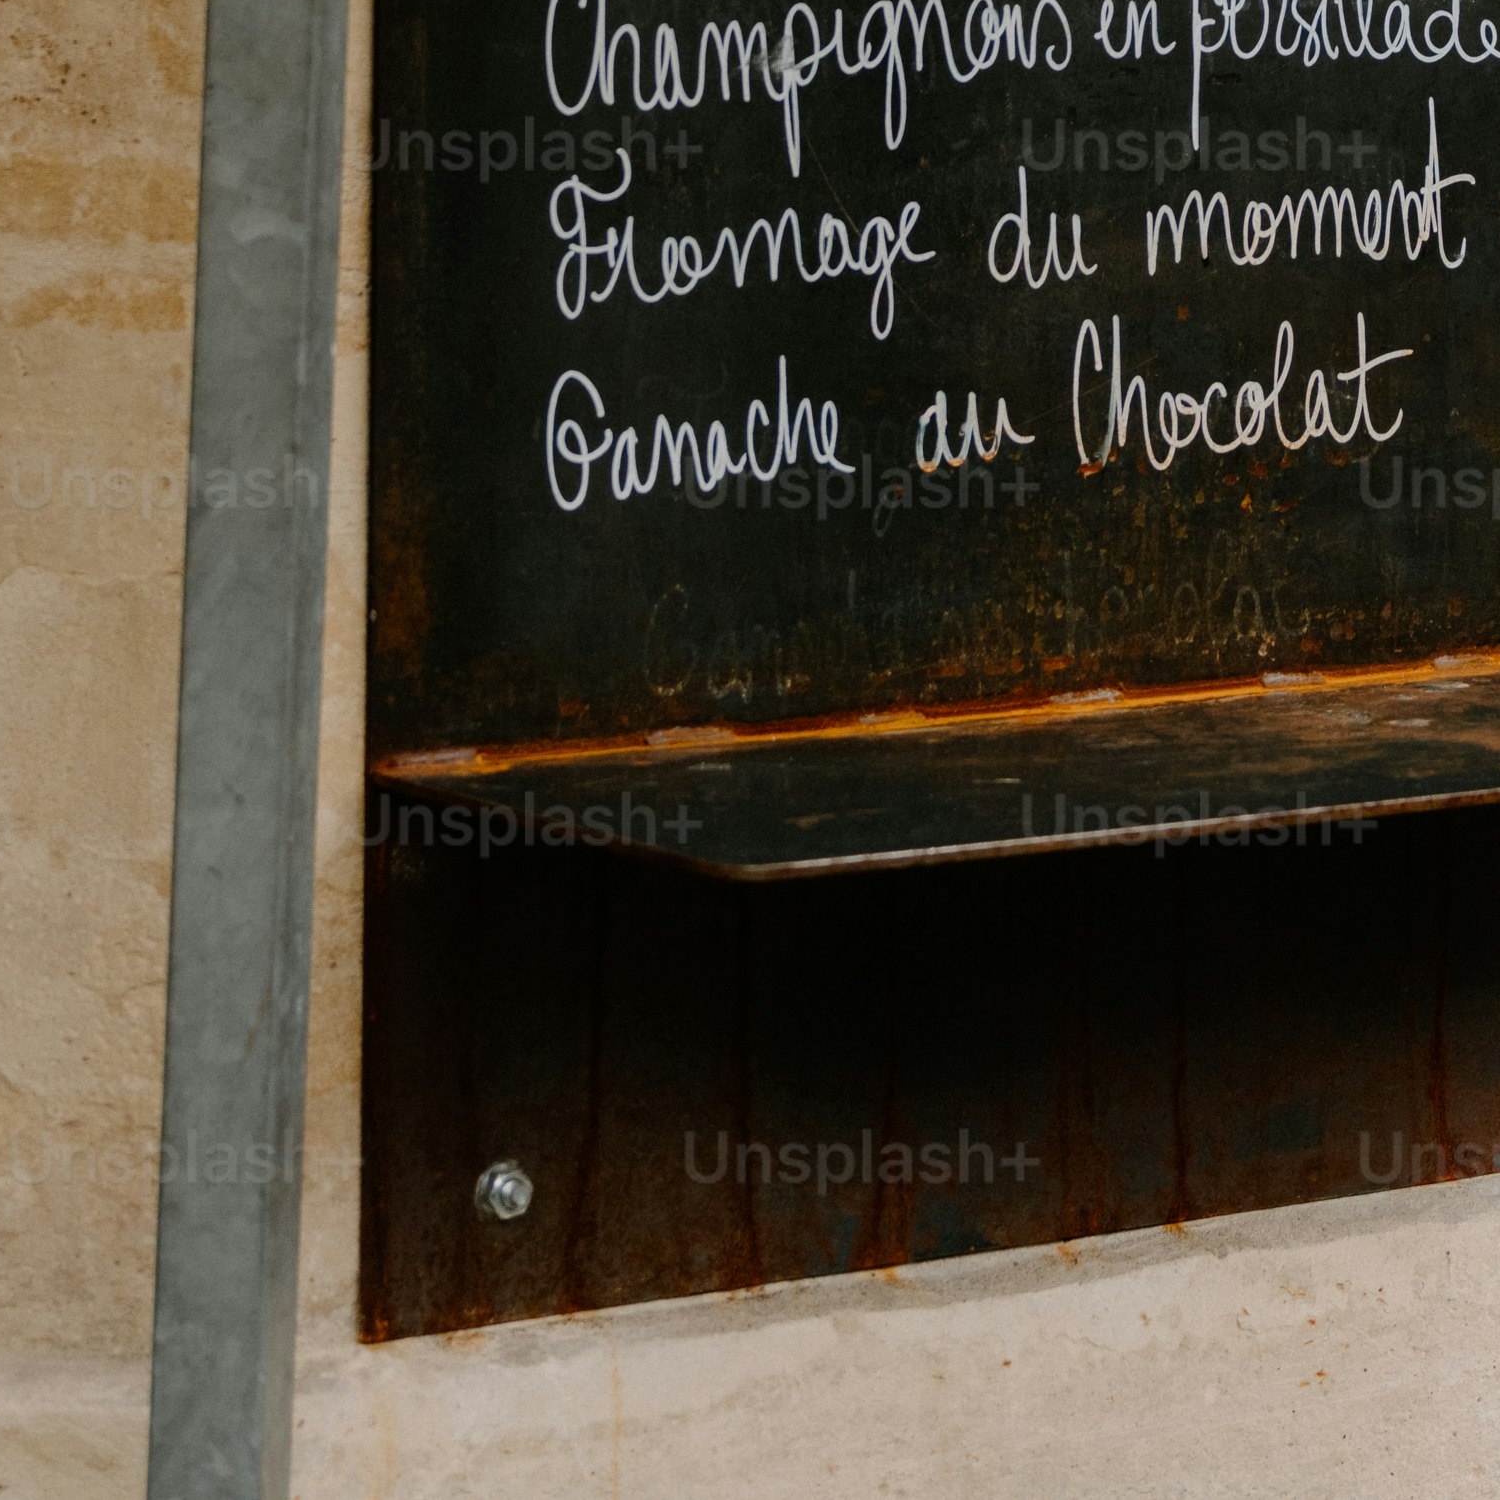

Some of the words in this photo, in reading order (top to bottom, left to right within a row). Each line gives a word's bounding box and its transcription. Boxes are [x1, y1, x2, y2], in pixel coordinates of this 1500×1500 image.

[549, 147, 937, 341] Fromage
[987, 164, 1099, 290] du
[1146, 96, 1477, 278] moment
[544, 354, 857, 512] Ganache
[915, 389, 1037, 474] au
[1071, 313, 1415, 476] Chocolat
